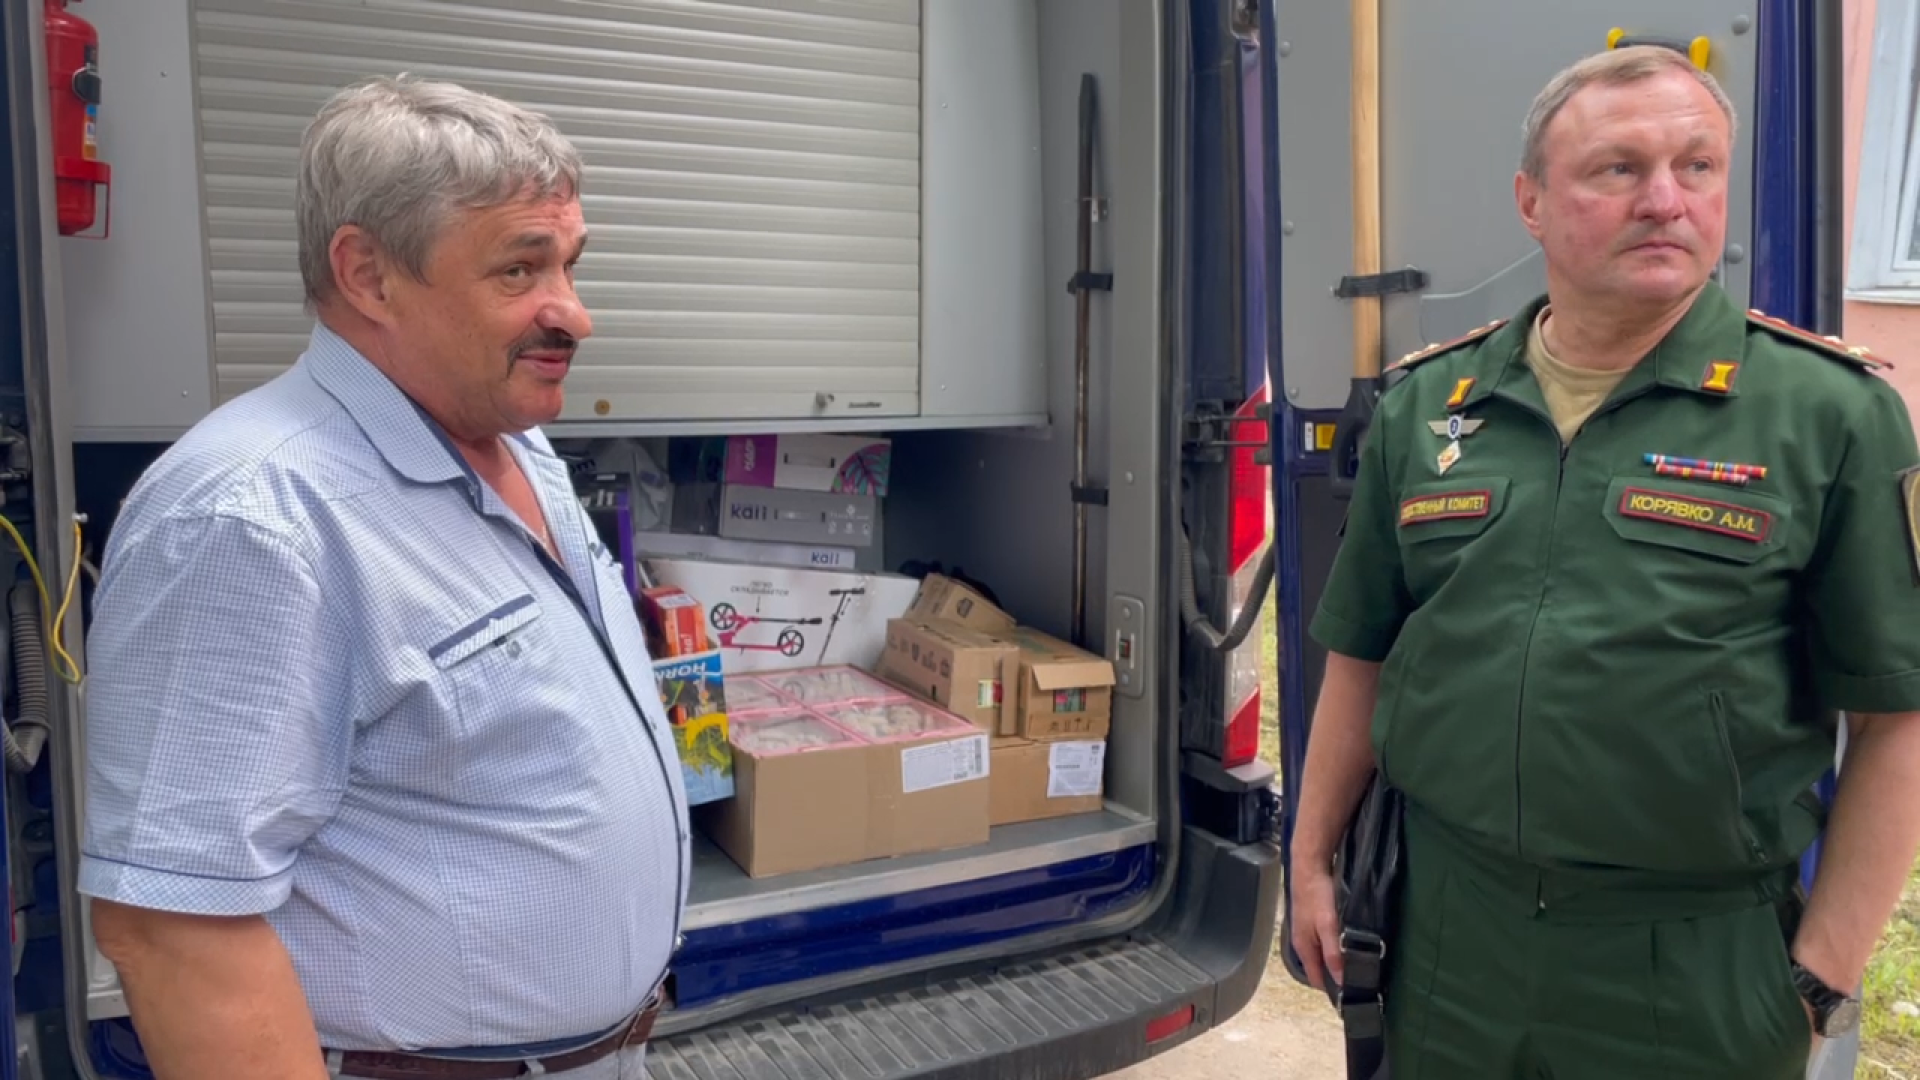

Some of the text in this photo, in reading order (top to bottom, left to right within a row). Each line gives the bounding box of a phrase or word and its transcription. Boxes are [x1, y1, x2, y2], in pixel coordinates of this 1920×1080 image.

[1448, 495, 1486, 511] КОМИТЕТ
[1631, 494, 1756, 532] КОРЯВКО А.М.
